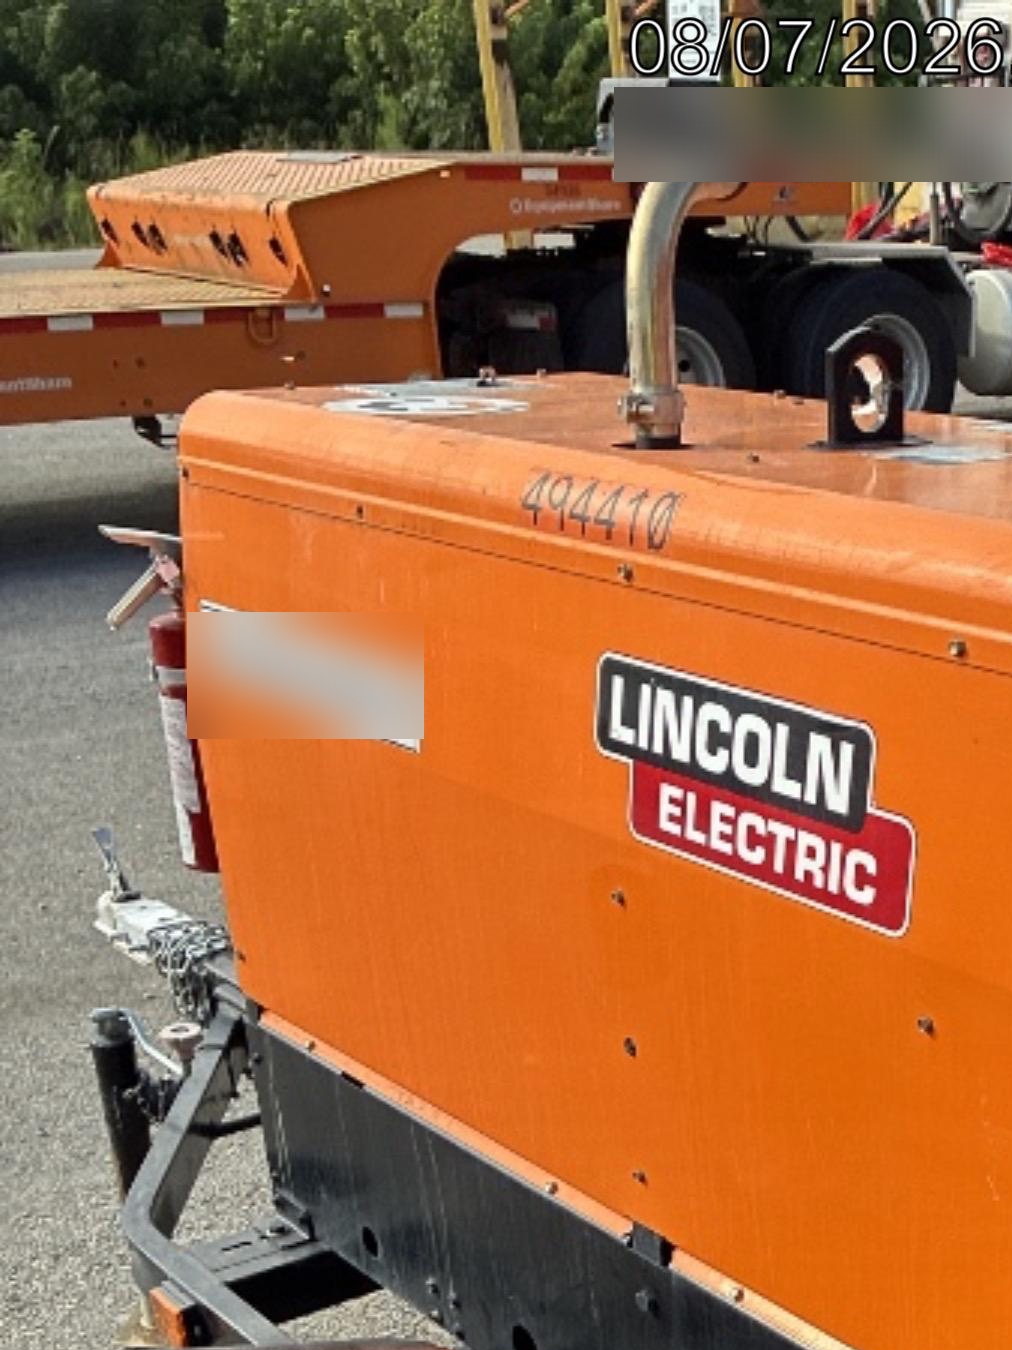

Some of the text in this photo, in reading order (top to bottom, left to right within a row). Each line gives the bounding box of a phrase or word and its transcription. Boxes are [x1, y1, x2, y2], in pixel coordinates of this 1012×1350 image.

[521, 471, 687, 549] 494410
[609, 675, 854, 814] LINCOLN
[659, 782, 877, 904] ELECTRIC
